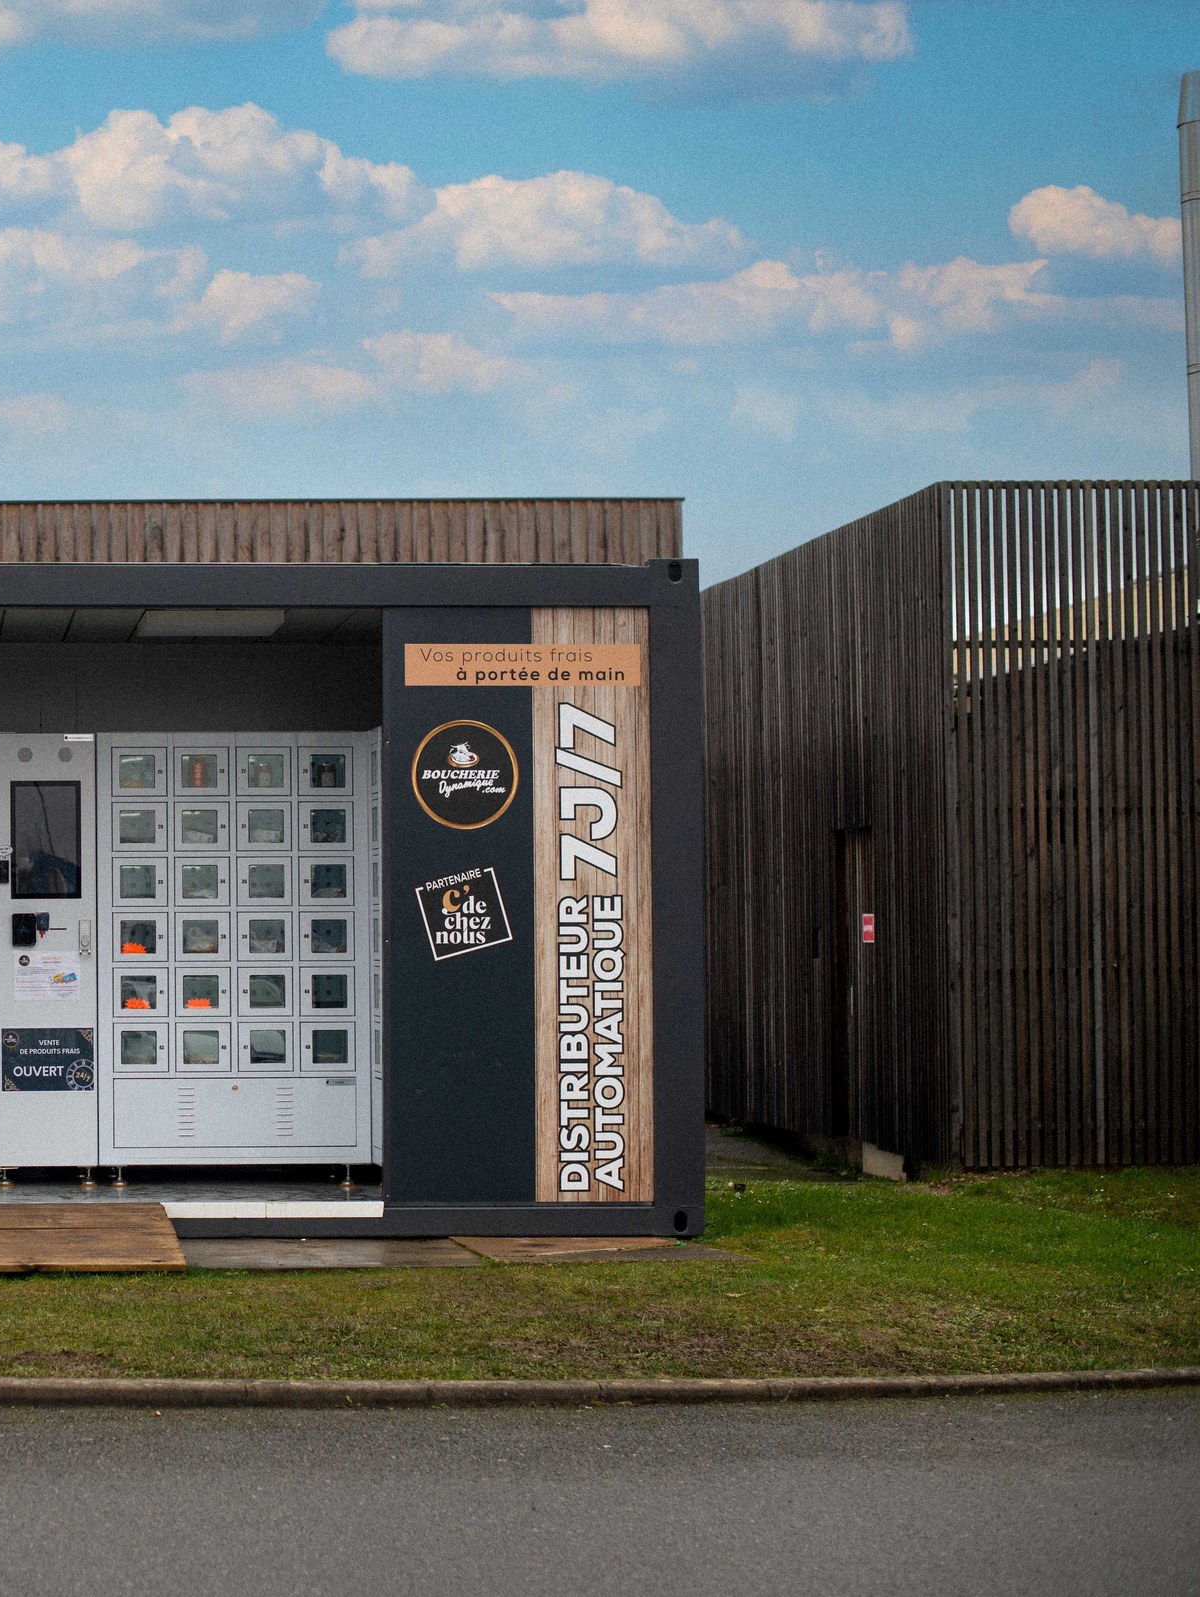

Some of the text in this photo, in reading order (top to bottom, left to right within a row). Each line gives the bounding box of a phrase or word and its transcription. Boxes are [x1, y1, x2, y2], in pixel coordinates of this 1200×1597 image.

[420, 648, 593, 665] Vos produits frais
[456, 667, 625, 684] à portée de main
[422, 769, 500, 780] BOUCHERIE
[439, 778, 493, 798] Dynamique
[555, 702, 623, 881] 7J/7
[425, 868, 482, 891] PARTENAIRE
[444, 911, 491, 930] chez
[435, 929, 486, 944] nous
[557, 895, 591, 1192] DISTRIBUTEUR
[592, 895, 627, 1193] AUTOMATIQUE
[13, 1065, 64, 1077] OUVERT
